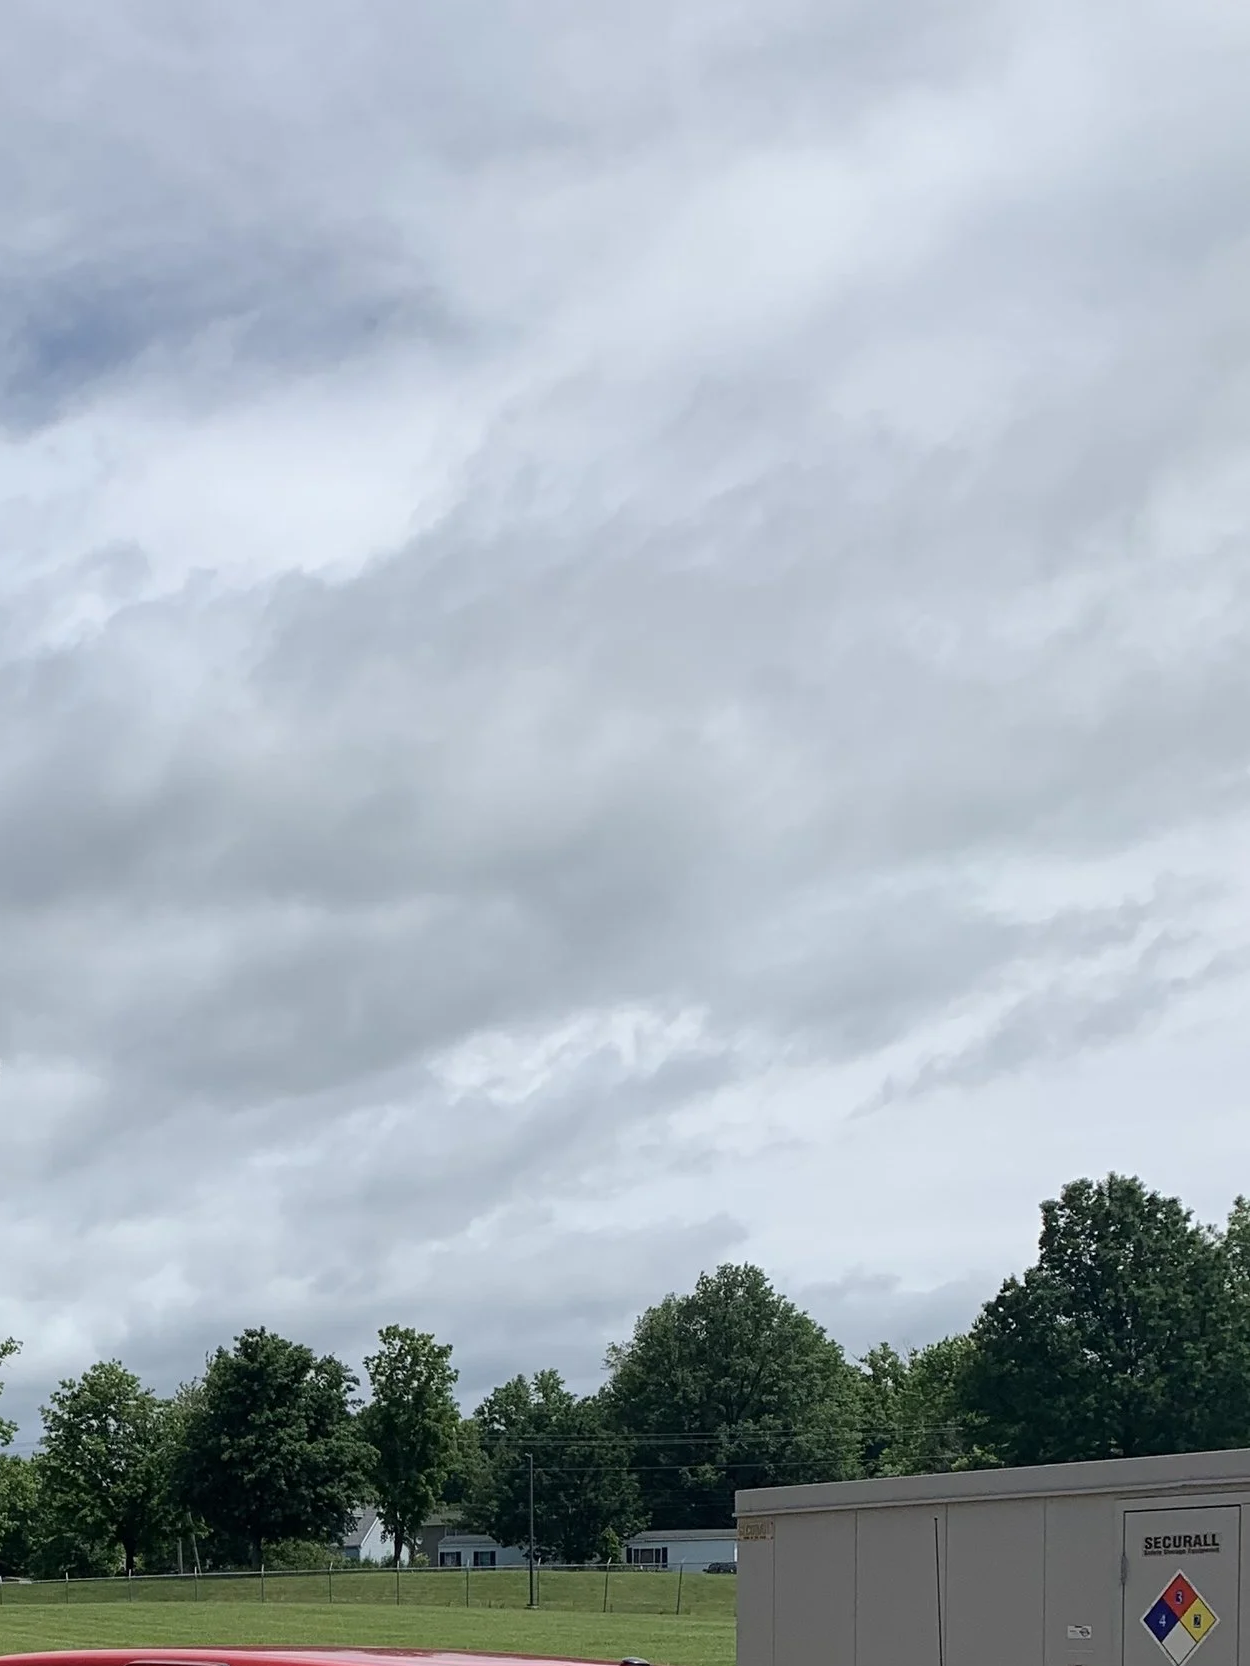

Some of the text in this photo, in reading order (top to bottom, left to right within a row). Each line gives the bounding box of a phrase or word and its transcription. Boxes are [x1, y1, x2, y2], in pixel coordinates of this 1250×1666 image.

[1144, 1533, 1220, 1549] SECURALL
[1175, 1590, 1184, 1605] 3
[1158, 1614, 1167, 1628] 4
